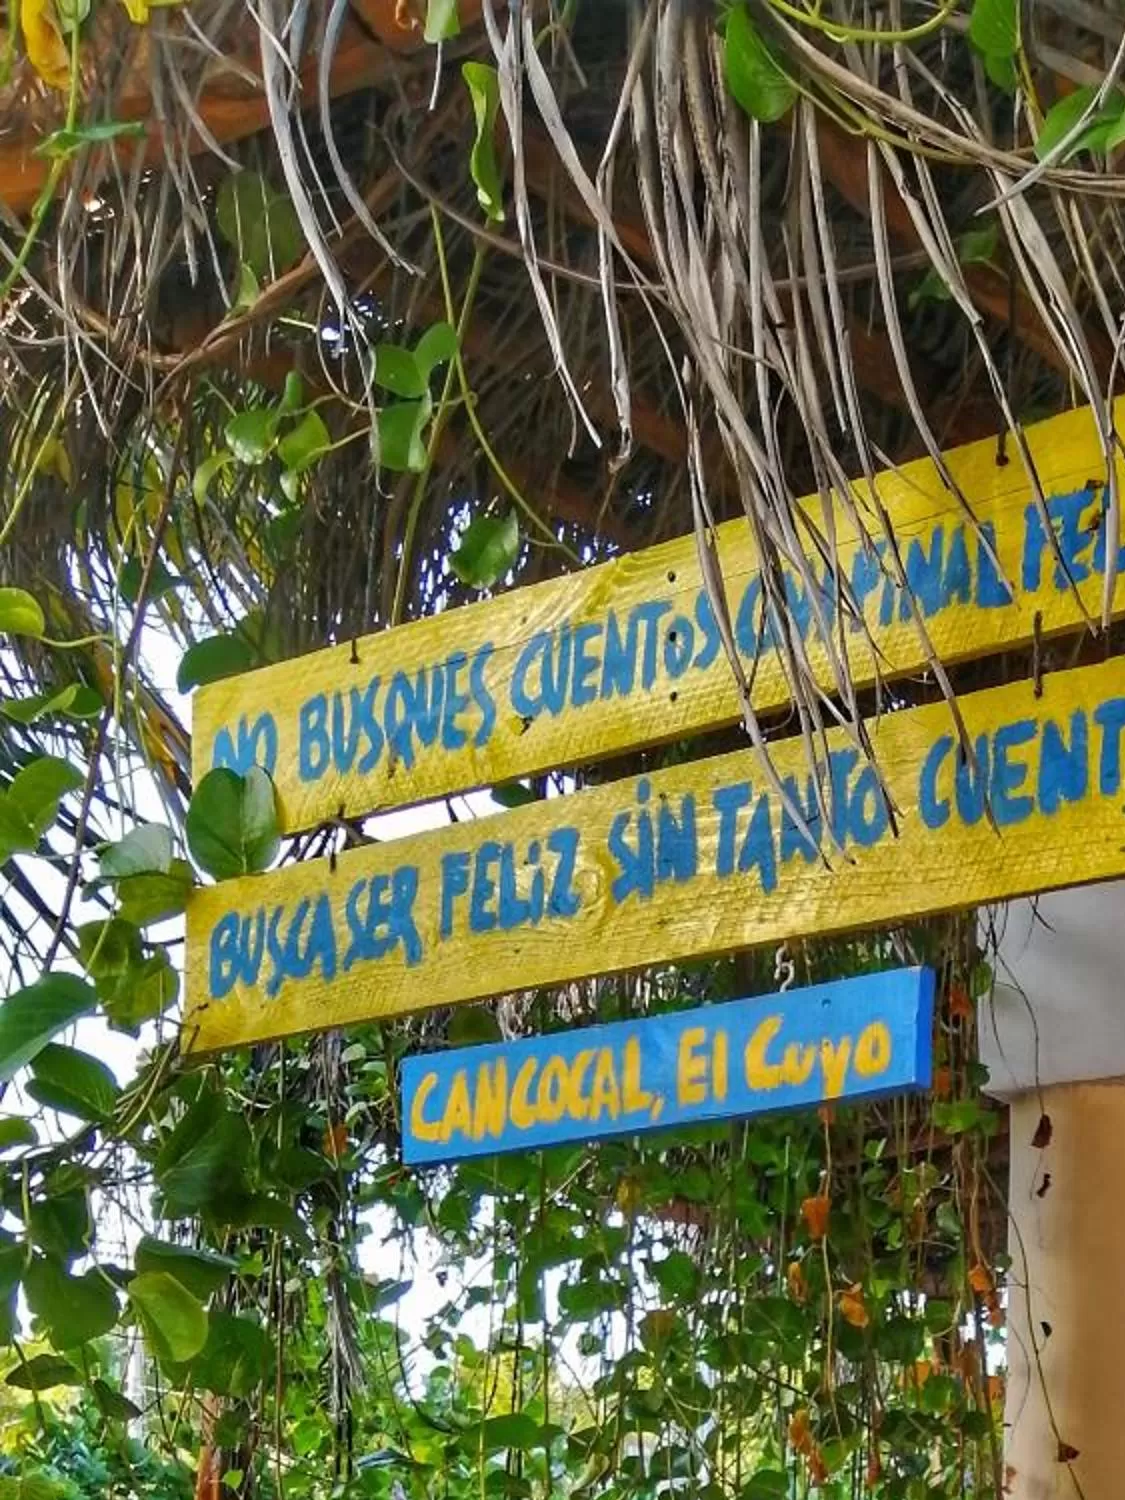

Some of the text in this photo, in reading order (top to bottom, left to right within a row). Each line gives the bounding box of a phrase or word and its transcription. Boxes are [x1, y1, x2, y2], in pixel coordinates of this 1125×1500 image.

[212, 711, 278, 779] NO
[299, 641, 497, 780] BUSQUES
[510, 588, 722, 718] CUENTOS
[851, 520, 1013, 628] FINAL
[209, 889, 337, 998] BUSCA
[342, 866, 422, 968] SER
[713, 746, 889, 895] TANTO
[410, 1034, 664, 1142] CANCOCAL,
[744, 1013, 893, 1099] Cuyo
